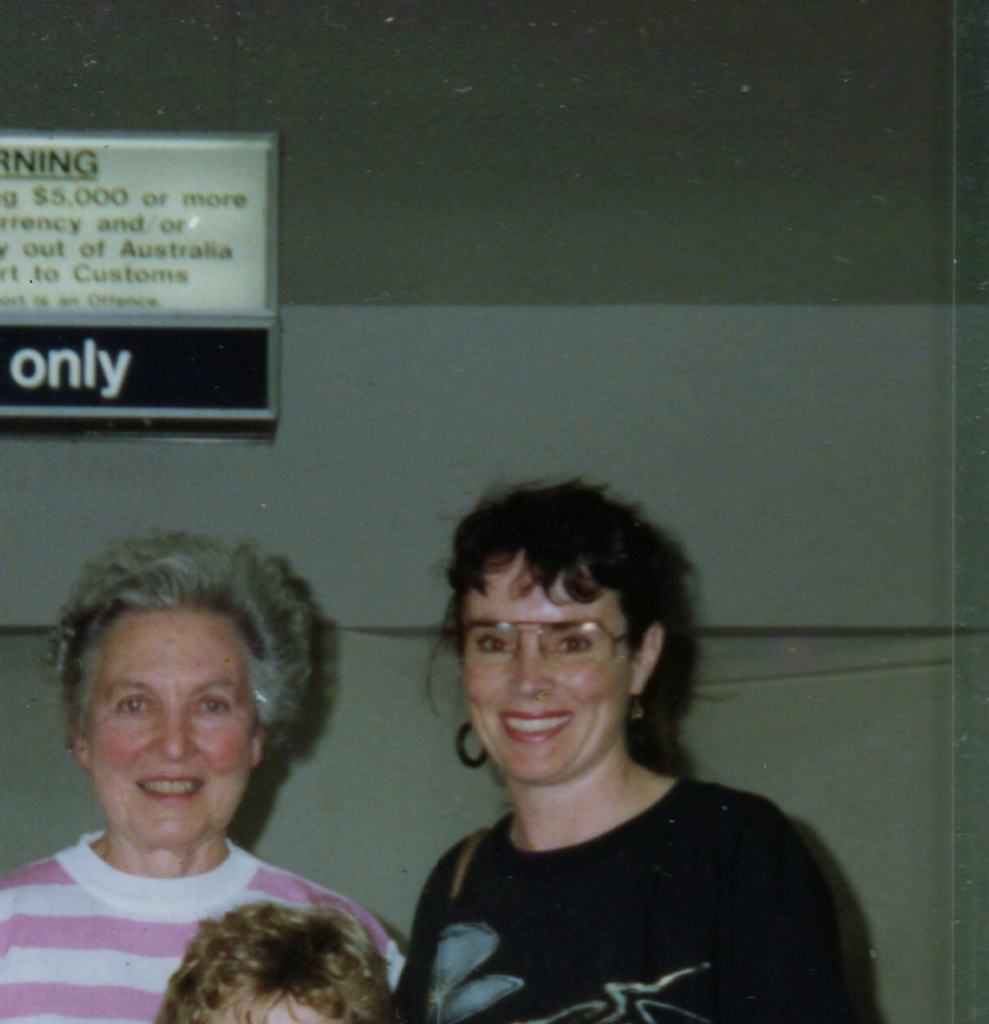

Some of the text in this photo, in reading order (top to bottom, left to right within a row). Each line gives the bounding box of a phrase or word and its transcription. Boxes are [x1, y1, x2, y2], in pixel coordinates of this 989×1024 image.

[142, 190, 168, 206] or
[182, 191, 248, 207] more
[22, 240, 66, 257] out
[80, 240, 107, 257] of
[119, 240, 234, 260] Australia
[33, 265, 60, 282] to
[73, 264, 189, 284] Customs
[10, 338, 132, 398] only
